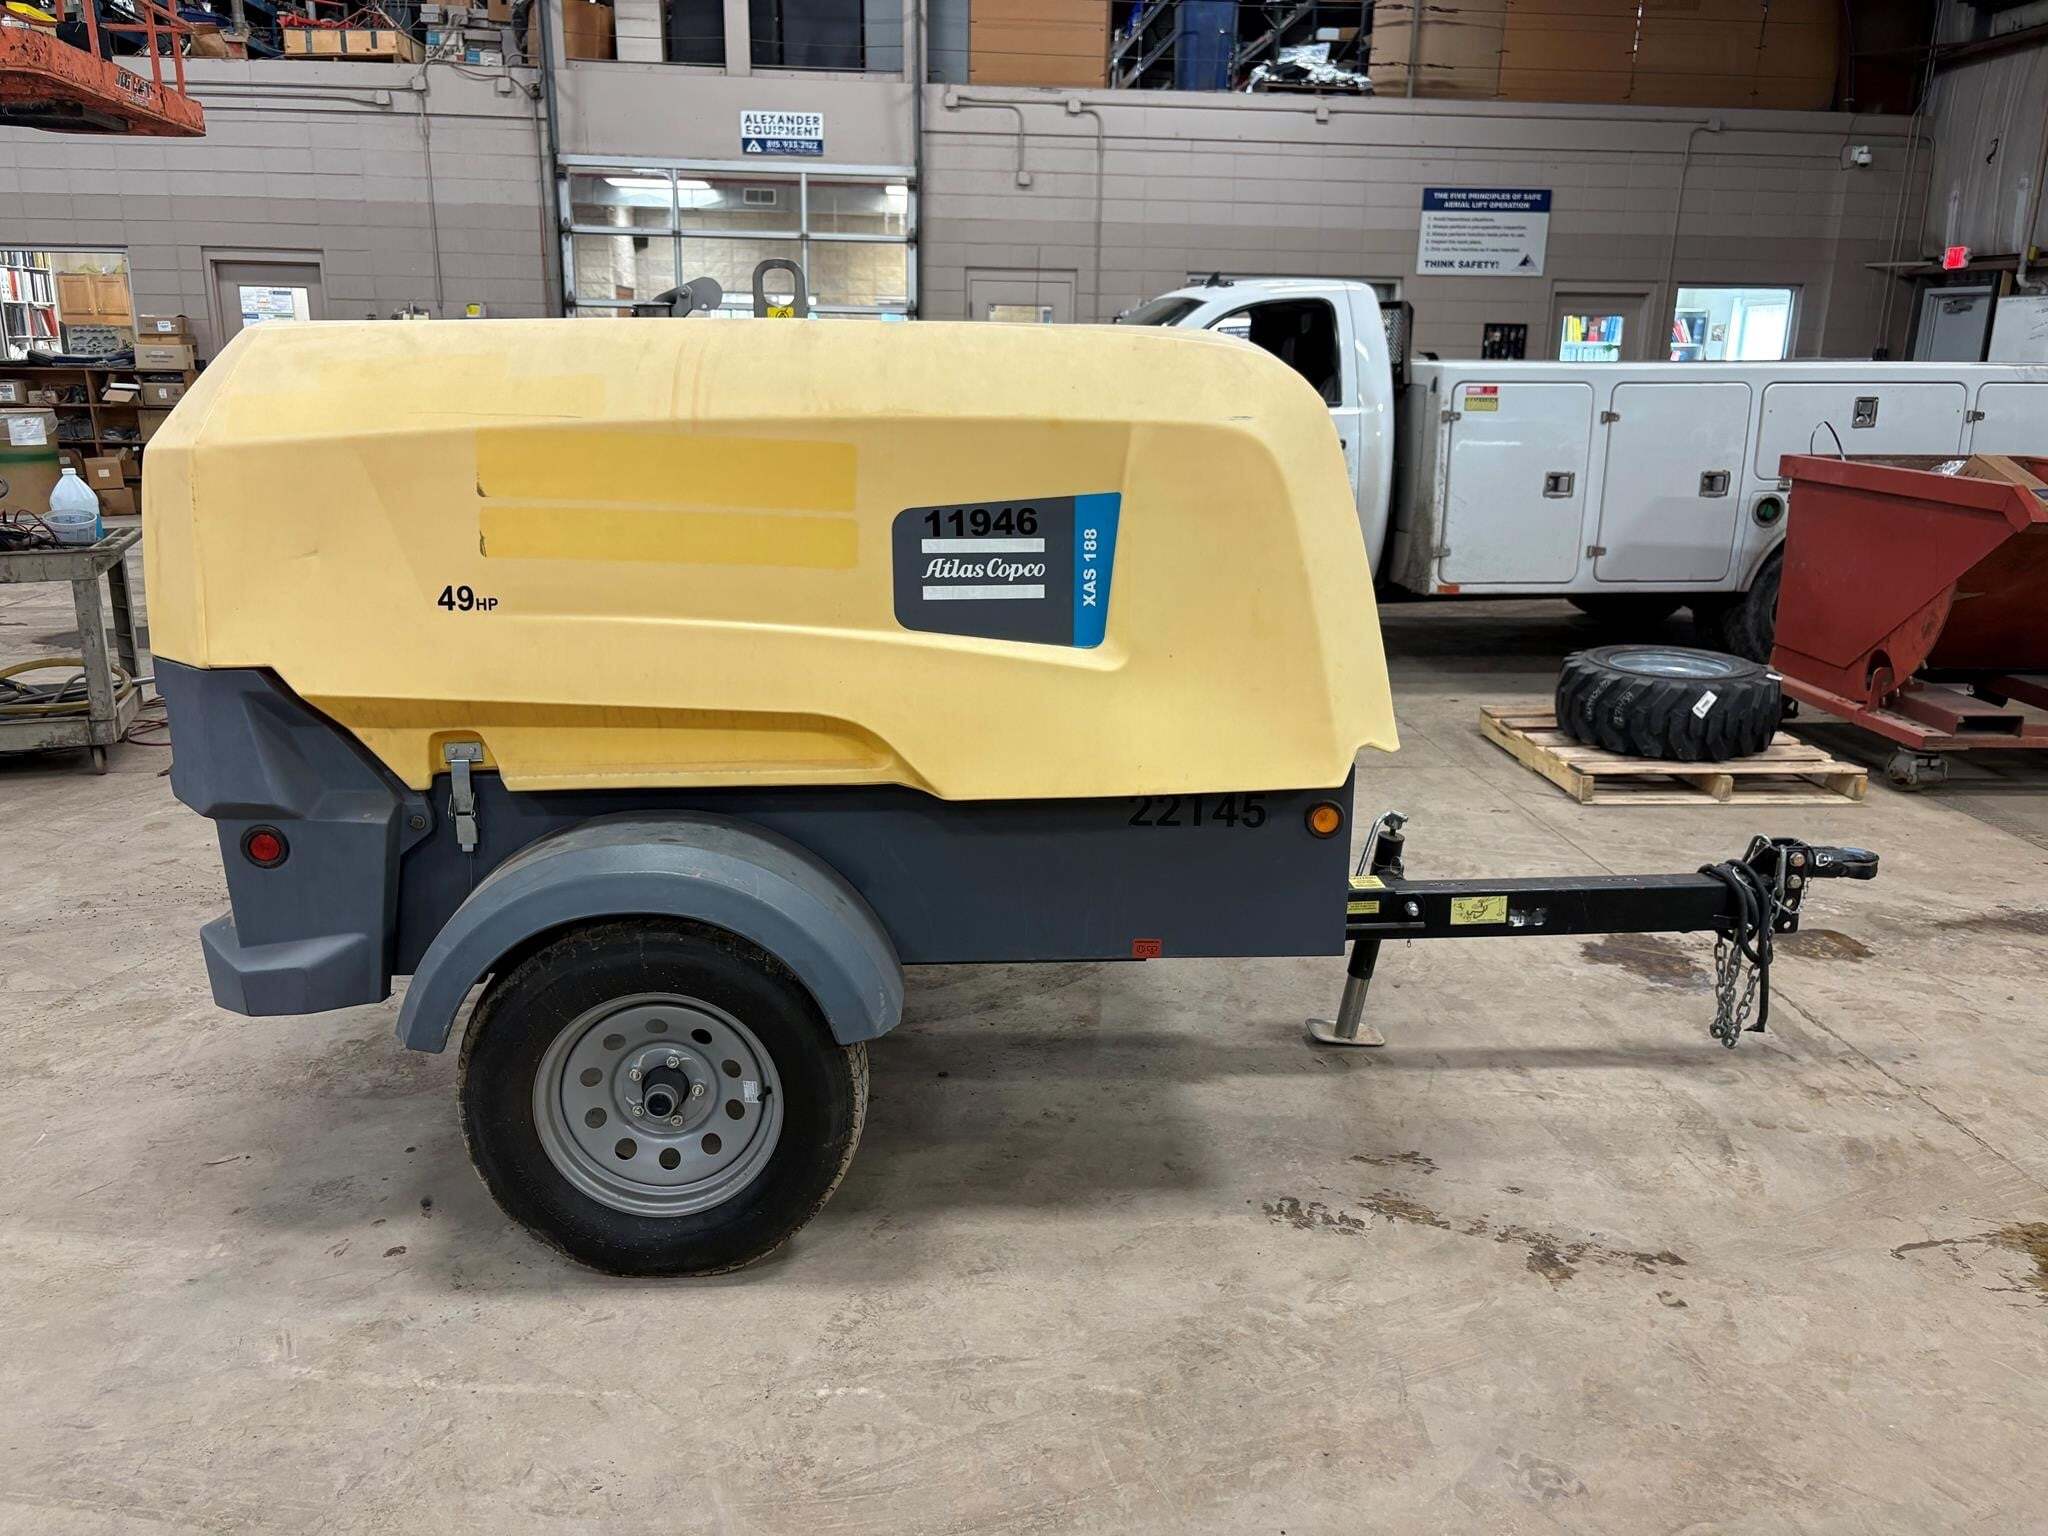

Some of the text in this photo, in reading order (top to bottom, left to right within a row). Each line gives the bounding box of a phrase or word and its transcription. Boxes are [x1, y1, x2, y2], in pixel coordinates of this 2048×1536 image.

[744, 114, 821, 126] ALEXANDER
[745, 125, 820, 137] EQUIPMENT
[1468, 192, 1511, 201] PRINCIPLES
[1424, 260, 1500, 269] THINK SAFETY!
[924, 507, 1038, 537] 11946
[922, 558, 1046, 582] Atlas Copco
[1083, 528, 1098, 607] XAS 188
[1128, 794, 1266, 828] 22145
